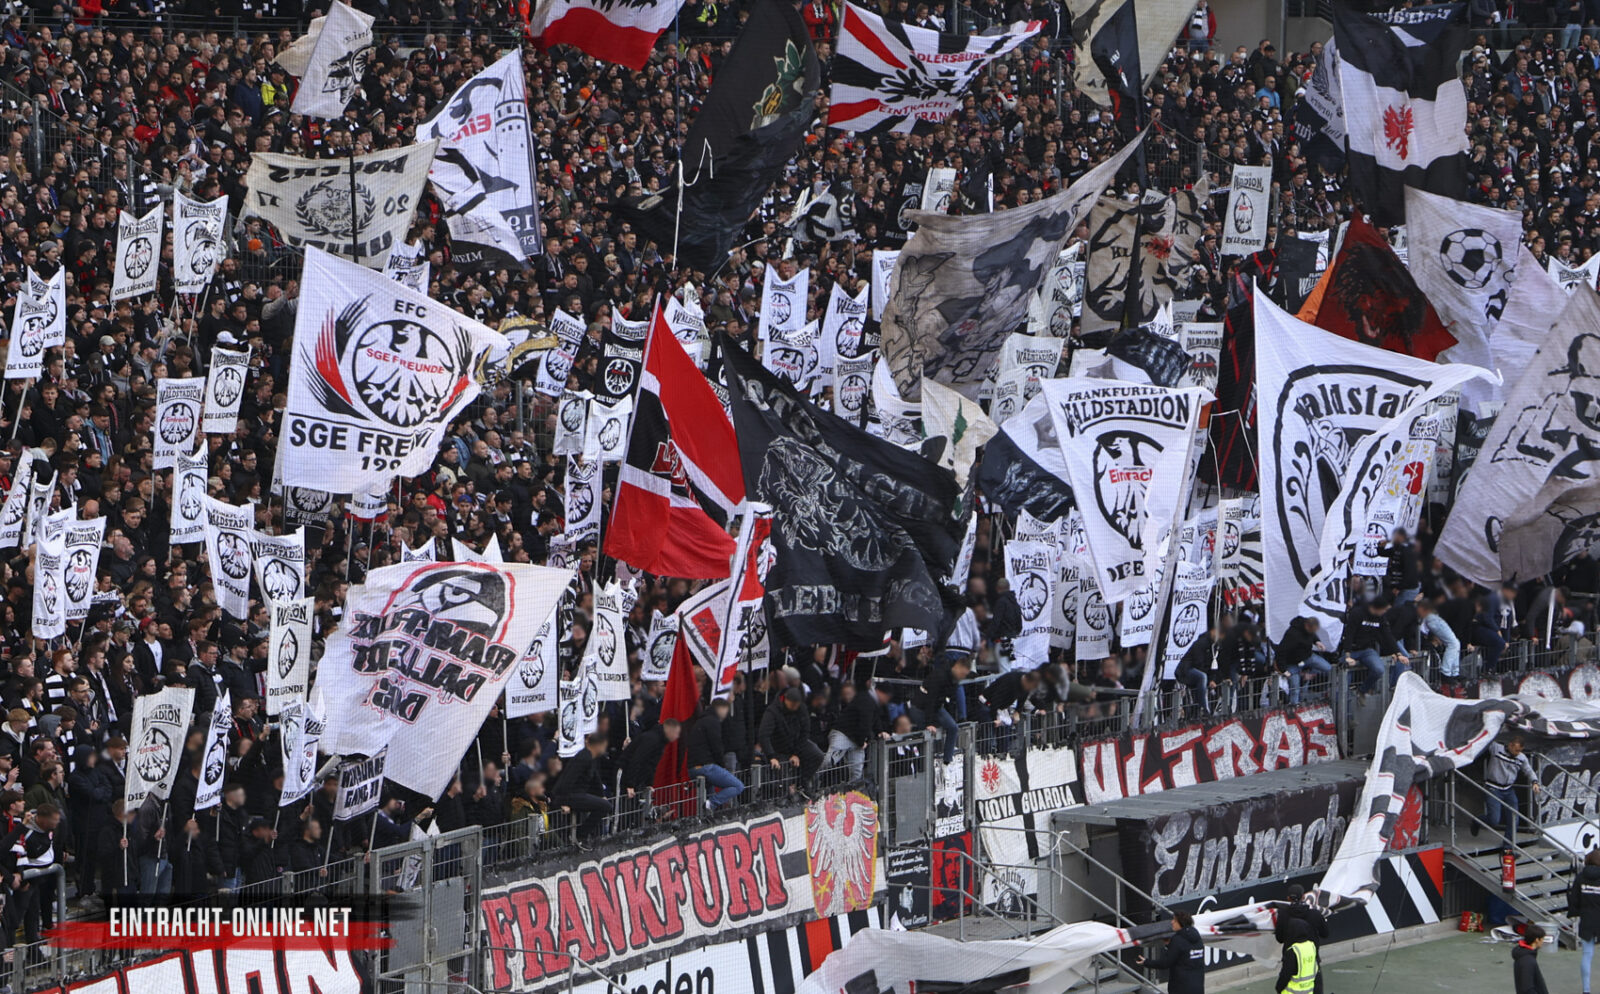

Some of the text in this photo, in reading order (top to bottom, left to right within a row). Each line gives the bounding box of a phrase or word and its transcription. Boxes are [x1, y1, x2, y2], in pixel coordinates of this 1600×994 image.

[878, 101, 952, 115] EINTRACHT
[394, 300, 427, 318] EFC
[366, 348, 445, 375] SGE FREUNDE
[1068, 386, 1168, 401] FRANKFURTER
[1294, 384, 1414, 423] aldsta
[1060, 393, 1189, 438] WALDSTADION
[290, 419, 412, 458] SGE FRE
[297, 510, 329, 521] FREUNDE
[512, 693, 546, 704] DIE LEGENDE
[1082, 704, 1341, 805] ULTRAS
[128, 792, 146, 801] DIE
[979, 785, 1076, 822] NOVA GUARDIA
[481, 817, 789, 991] FRANKFURT
